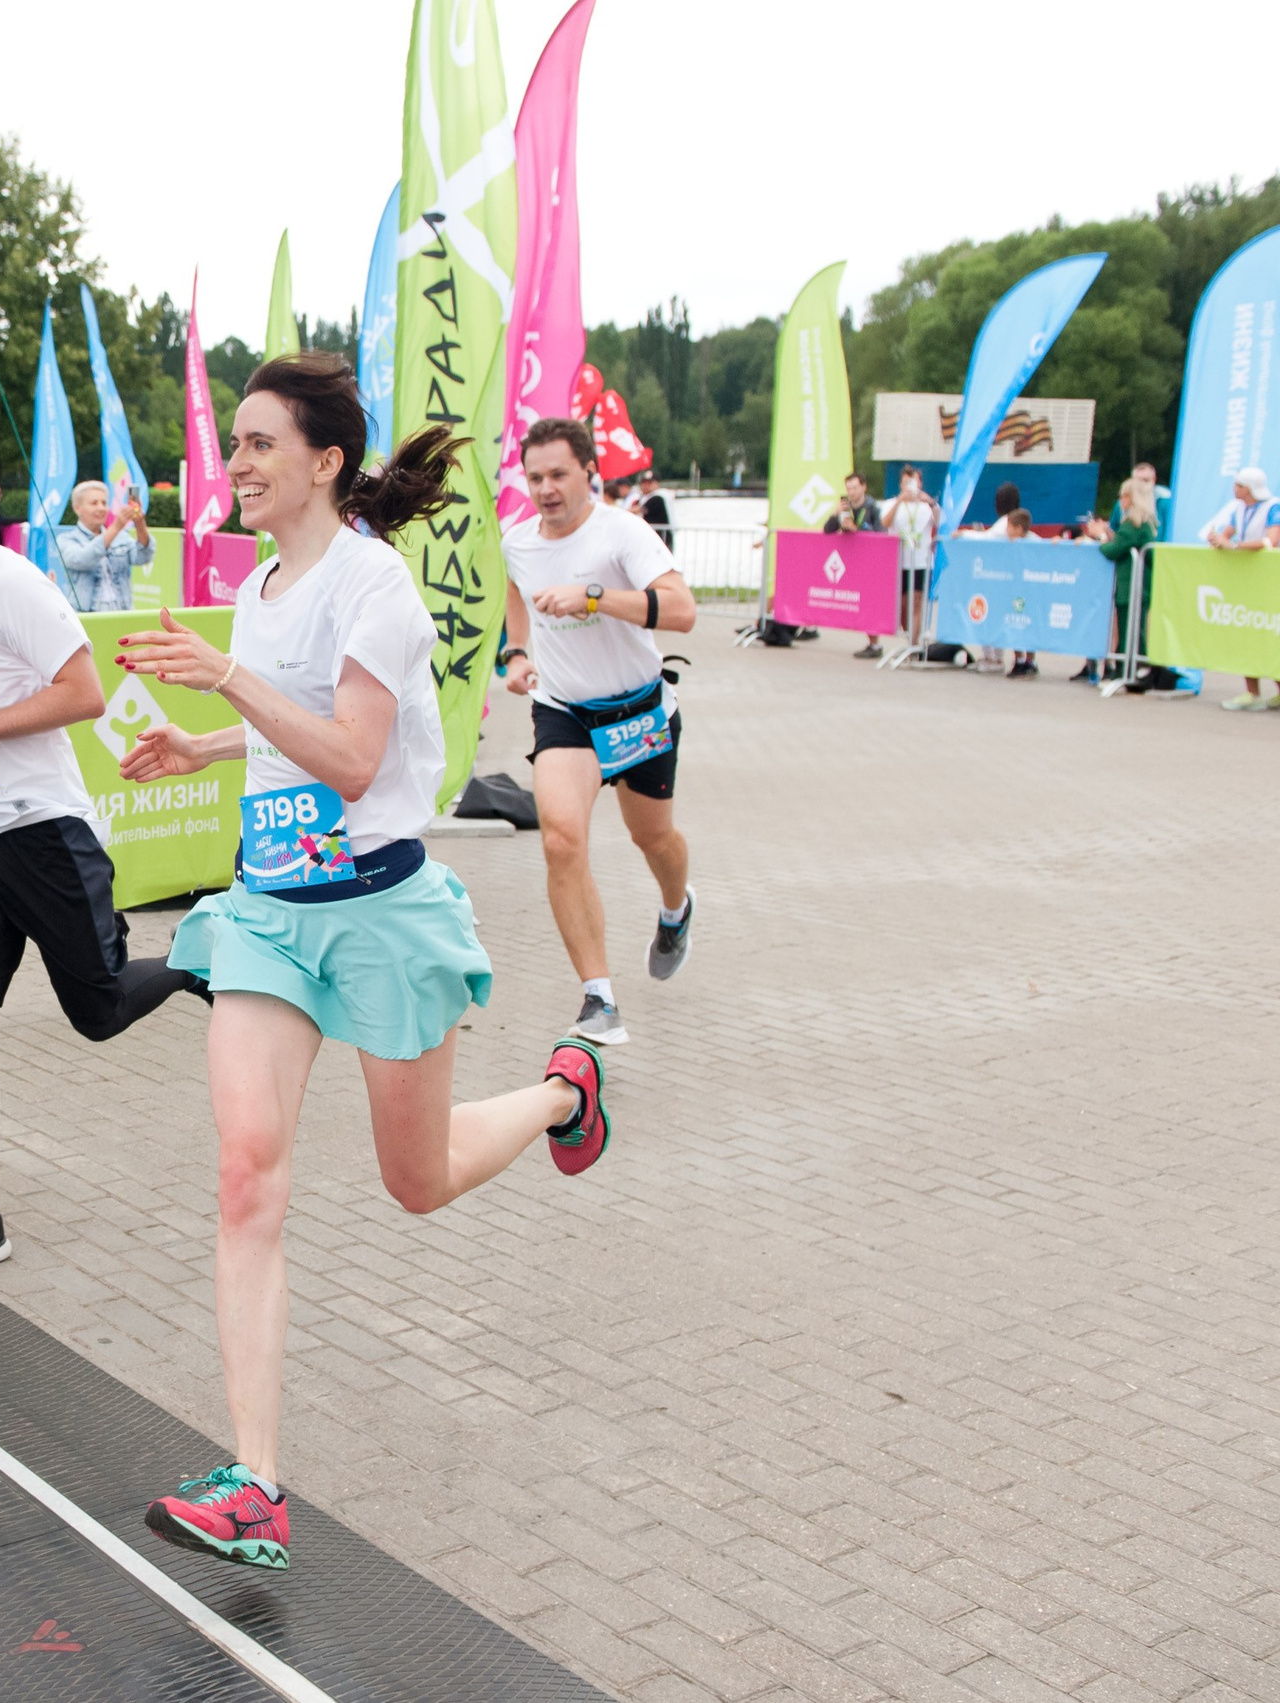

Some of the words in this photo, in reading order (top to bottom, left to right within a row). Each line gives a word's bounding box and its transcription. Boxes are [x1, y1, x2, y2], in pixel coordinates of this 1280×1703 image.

[195, 413, 216, 481] ЛИНИЯ
[605, 714, 655, 747] 3199
[250, 746, 263, 756] ЗА
[267, 746, 285, 759] БУ
[131, 780, 219, 815] ЖИЗНИ
[253, 792, 320, 831] 3198
[184, 816, 220, 838] фонд
